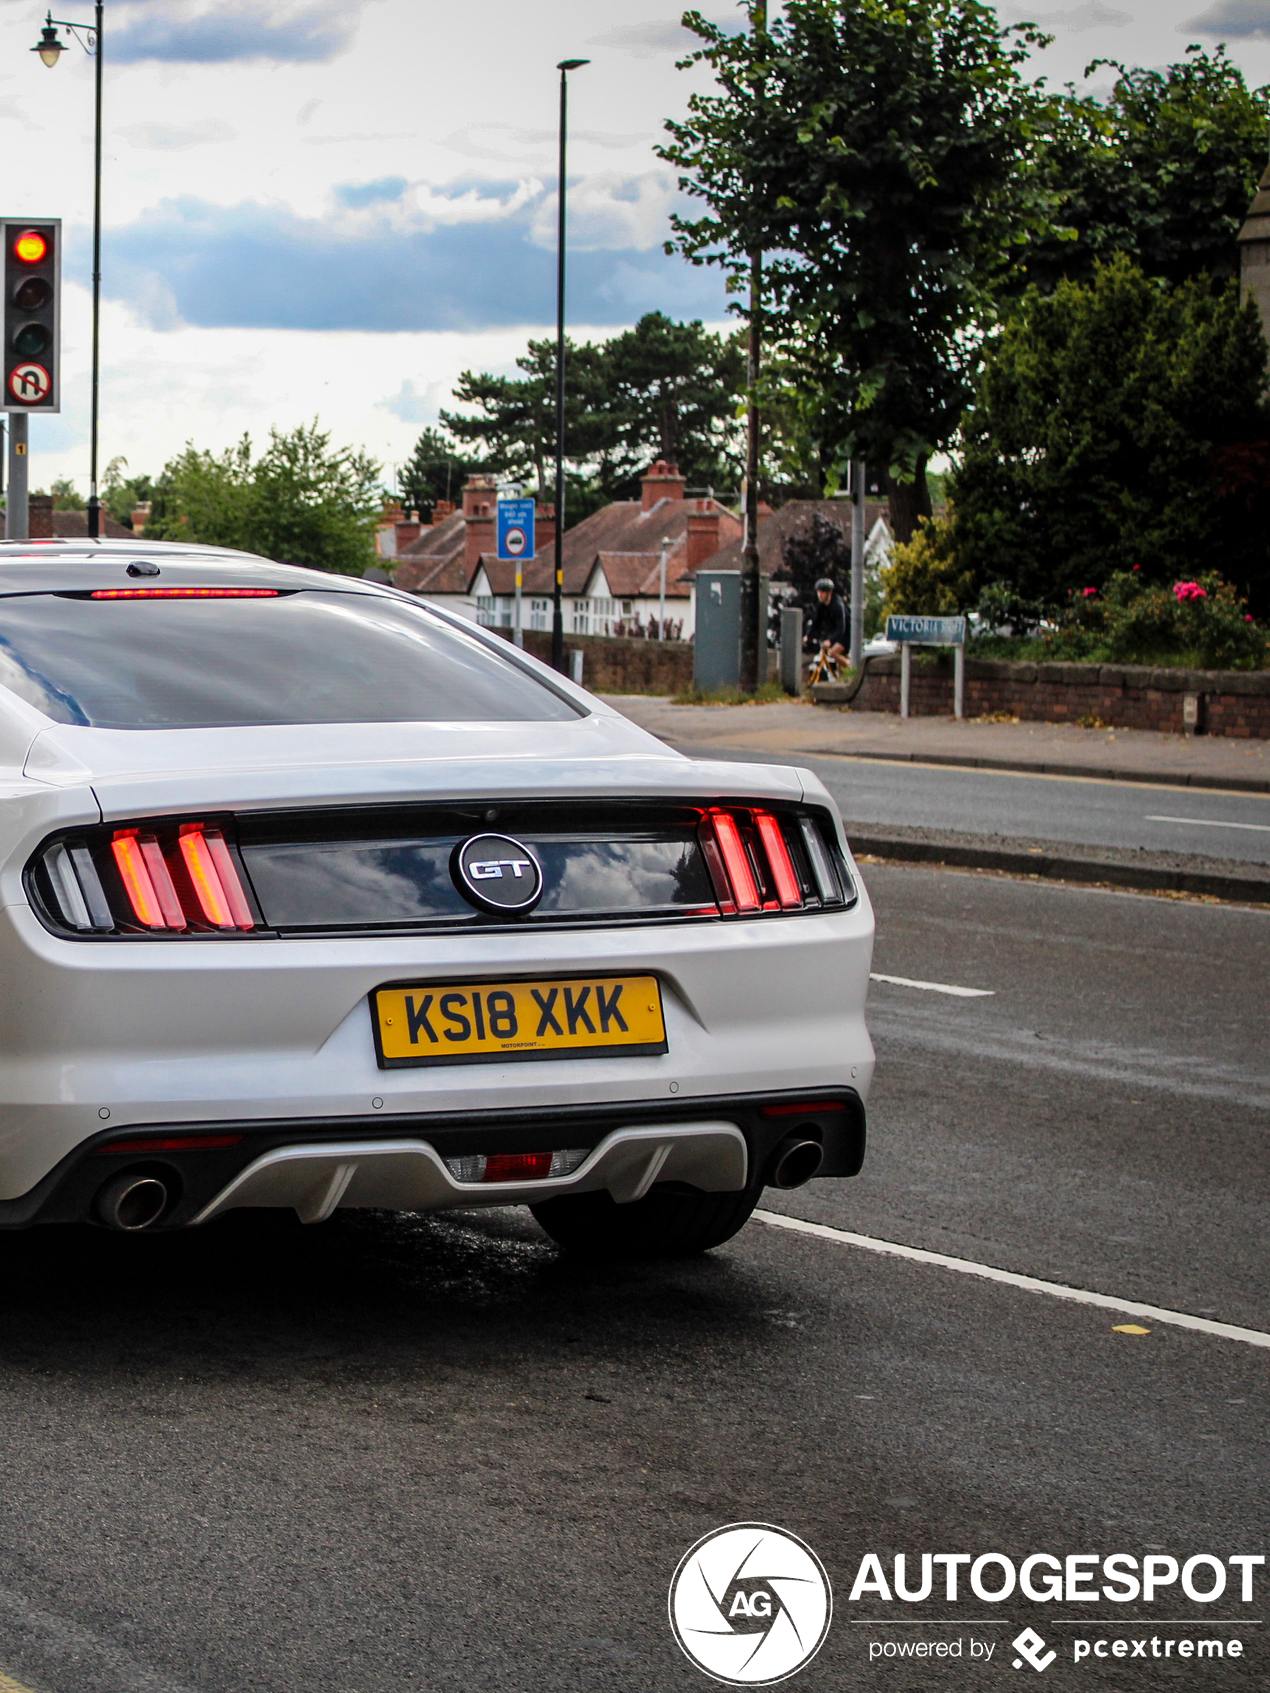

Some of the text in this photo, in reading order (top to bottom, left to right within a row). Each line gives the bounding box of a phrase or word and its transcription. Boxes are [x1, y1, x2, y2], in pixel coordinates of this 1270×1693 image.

[892, 619, 938, 633] VICTORIA
[469, 860, 531, 879] GT
[404, 984, 629, 1044] KS18 XKK
